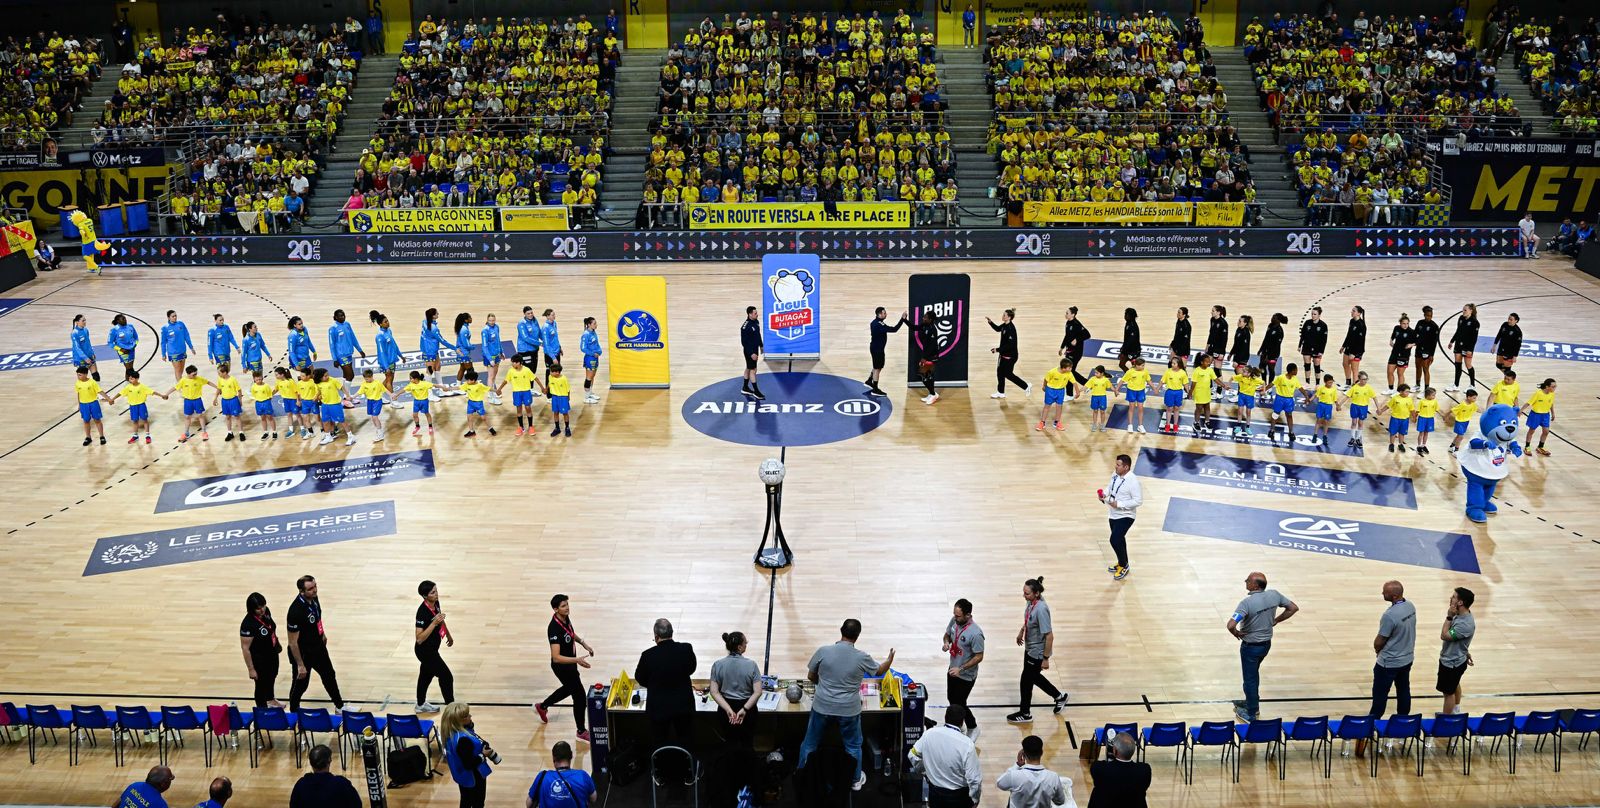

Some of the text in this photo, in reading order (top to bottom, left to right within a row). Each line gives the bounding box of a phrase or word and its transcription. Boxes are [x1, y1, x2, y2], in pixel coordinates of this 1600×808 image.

[1494, 143, 1510, 152] PLUS
[1527, 144, 1536, 152] DU
[1537, 144, 1562, 153] TERRAIN
[1576, 145, 1592, 154] AVEC
[110, 154, 142, 165] Metz
[376, 209, 493, 222] ALLEZ DRAGONNES
[710, 210, 725, 223] EN
[728, 210, 765, 223] ROUTE
[854, 211, 893, 222] PLACE
[897, 211, 907, 222] !!
[1049, 207, 1068, 216] Allez
[1068, 207, 1091, 217] METZ,
[1093, 207, 1103, 215] les
[1158, 207, 1173, 216] sont
[377, 224, 400, 232] VOS
[439, 223, 470, 232] SONT
[393, 240, 421, 248] Médias
[422, 240, 432, 248] de
[433, 239, 463, 248] référence
[1015, 233, 1050, 255] 20 ans
[1127, 235, 1154, 243] Médias
[1156, 235, 1166, 243] de
[1167, 234, 1198, 243] référence
[1286, 232, 1321, 254] 20 ans
[288, 239, 321, 260] 20 ans
[552, 236, 587, 259] 20 ans
[775, 300, 807, 311] LIGUE
[775, 312, 808, 323] BUTAGAZ
[693, 401, 824, 414] Allianz
[312, 464, 410, 480] Votre fournisseur
[316, 461, 380, 474] ÉLECTRICITÉ
[1200, 467, 1245, 479] JEAN
[1253, 474, 1347, 490] LEFEBVRE
[234, 478, 292, 493] uem
[1226, 482, 1318, 497] LORRAINE
[169, 510, 386, 547] LE BRAS FRÈRES
[1268, 539, 1365, 558] LORRAINE
[366, 767, 381, 801] SELECT
